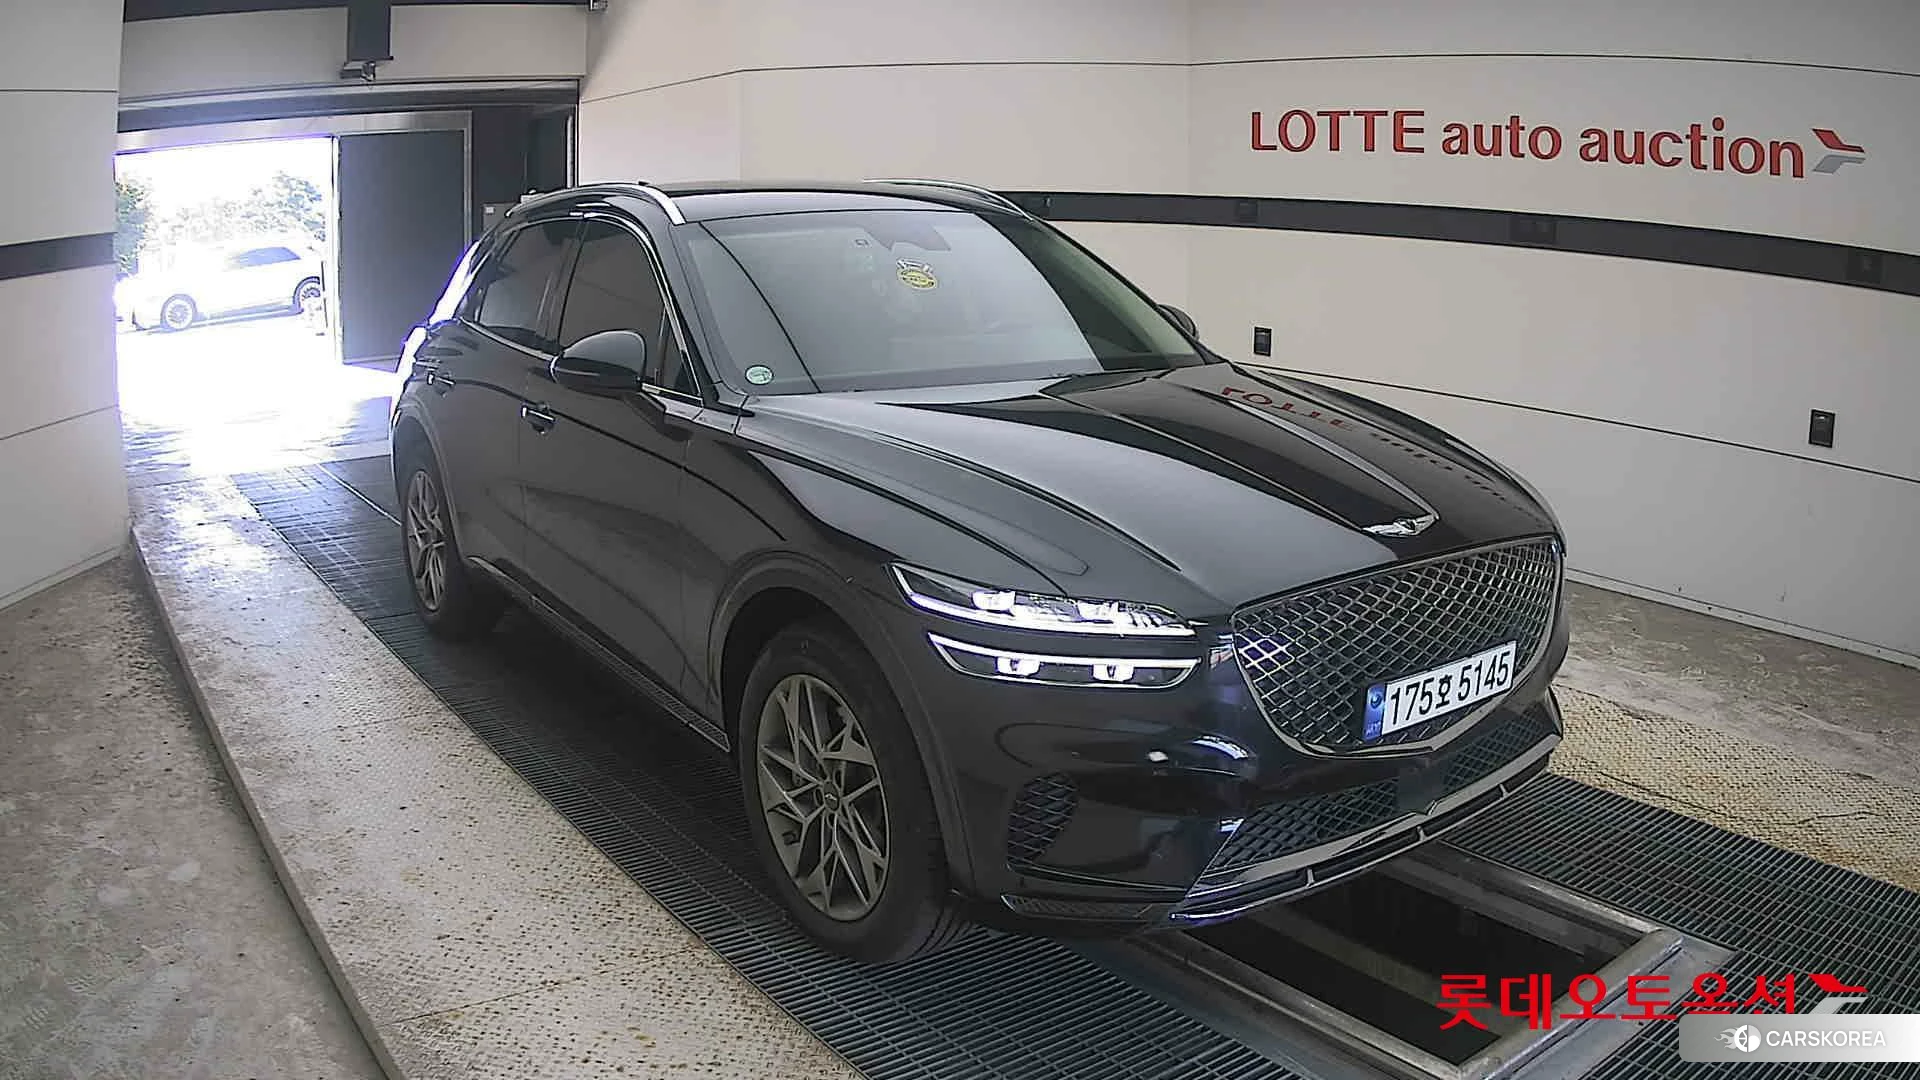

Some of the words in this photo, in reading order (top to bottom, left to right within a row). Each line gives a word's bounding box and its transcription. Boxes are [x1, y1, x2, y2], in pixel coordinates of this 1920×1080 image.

[1251, 109, 1425, 154] LOTTE
[1442, 115, 1562, 161] auto
[1579, 117, 1806, 179] auction
[1390, 674, 1453, 725] 175호
[1458, 651, 1511, 701] 5145
